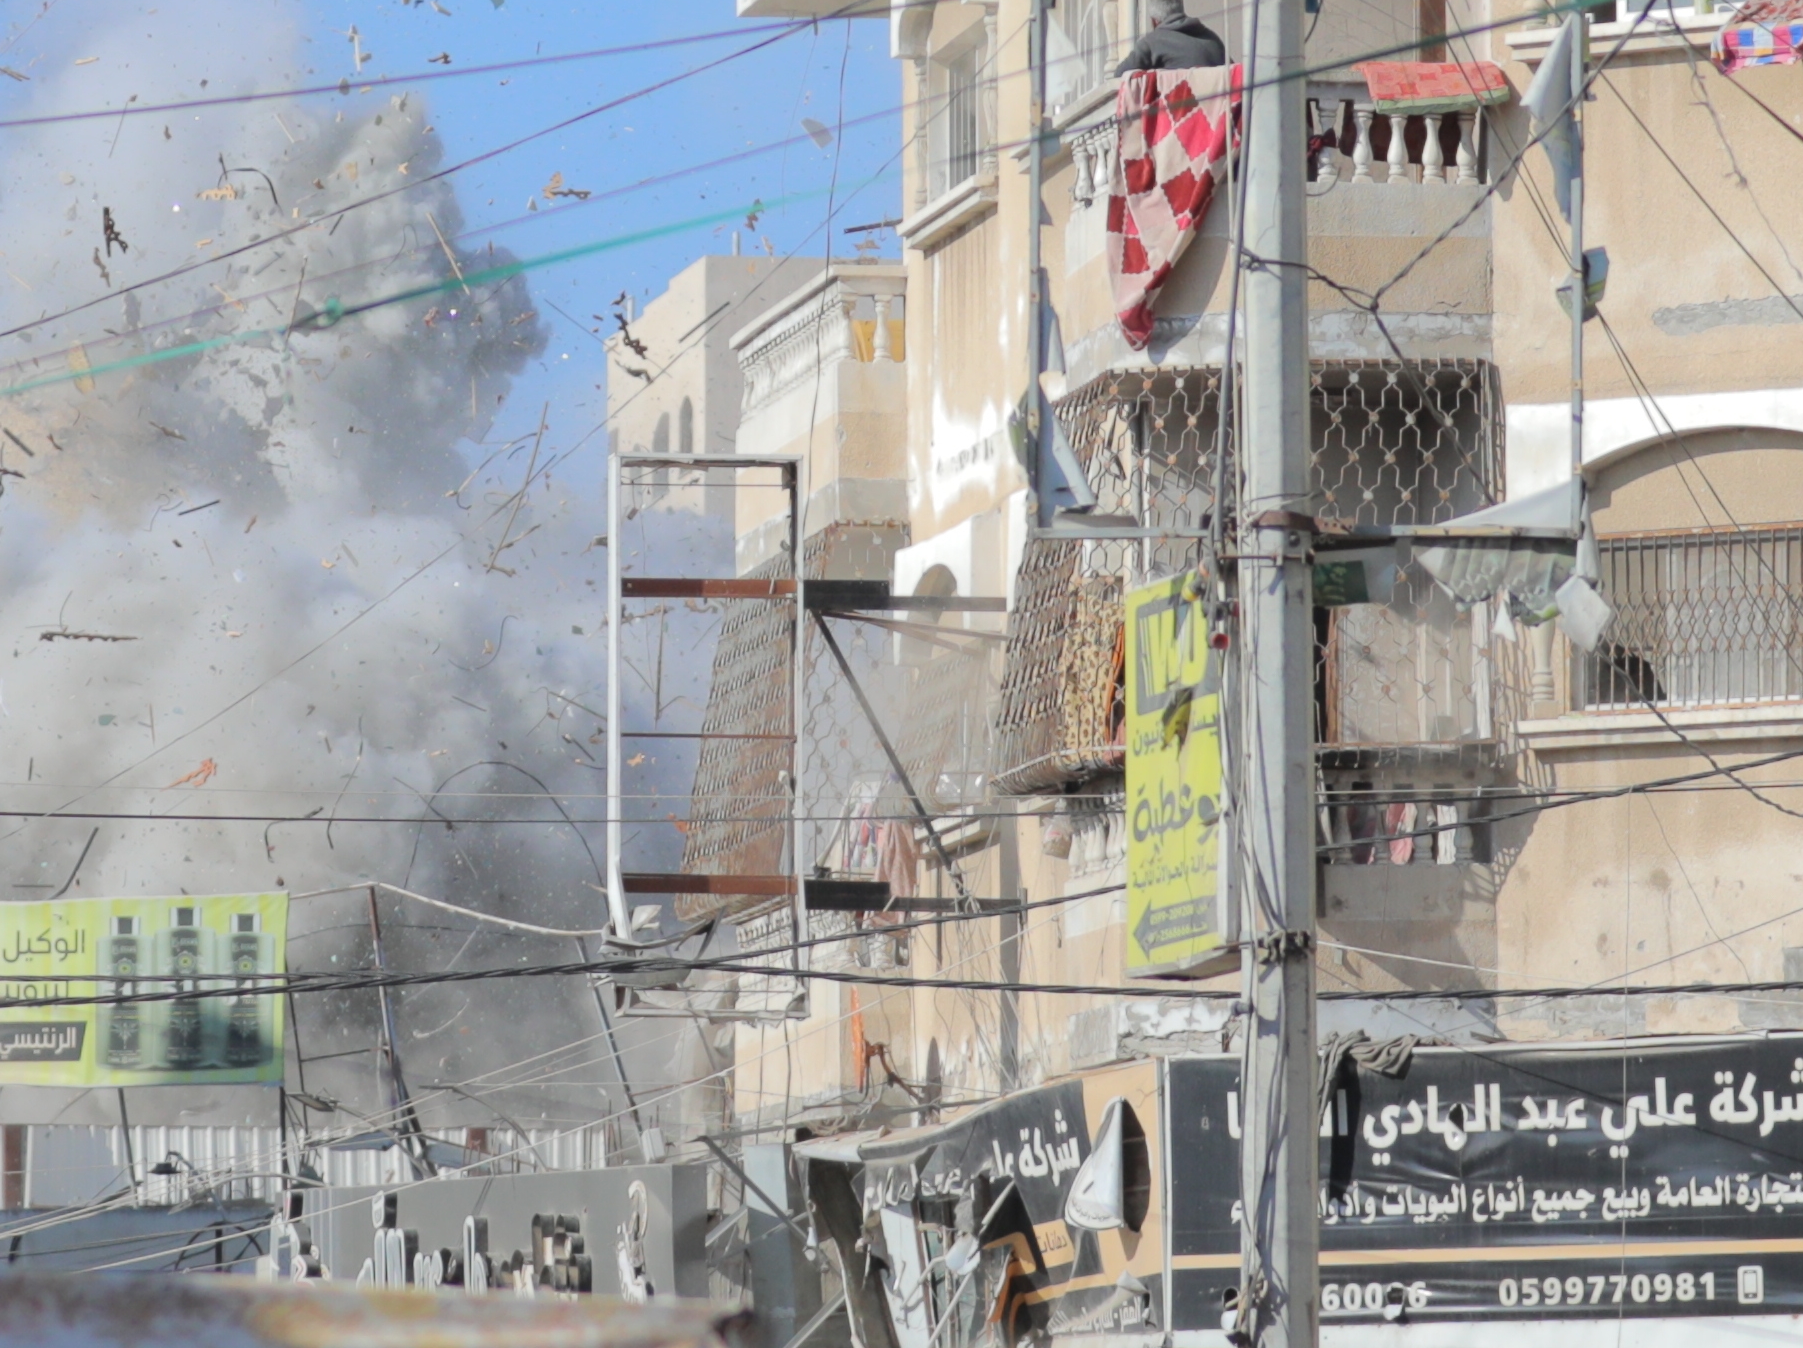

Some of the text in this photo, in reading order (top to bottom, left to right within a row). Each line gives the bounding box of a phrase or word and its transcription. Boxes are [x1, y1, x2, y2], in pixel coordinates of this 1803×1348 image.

[2, 928, 86, 963] الوكيل
[1362, 1082, 1502, 1166] الهادي
[1517, 1093, 1588, 1148] عبد
[1600, 1076, 1697, 1159] علي
[1018, 1108, 1082, 1188] شركة
[1318, 1180, 1377, 1225] وأدوا
[1381, 1182, 1467, 1224] البويات
[1470, 1175, 1525, 1223] أنواع
[1531, 1183, 1596, 1223] جميع
[1601, 1188, 1651, 1221] وبيع
[1656, 1173, 1731, 1208] العامة
[1498, 1271, 1716, 1308] 0599770981
